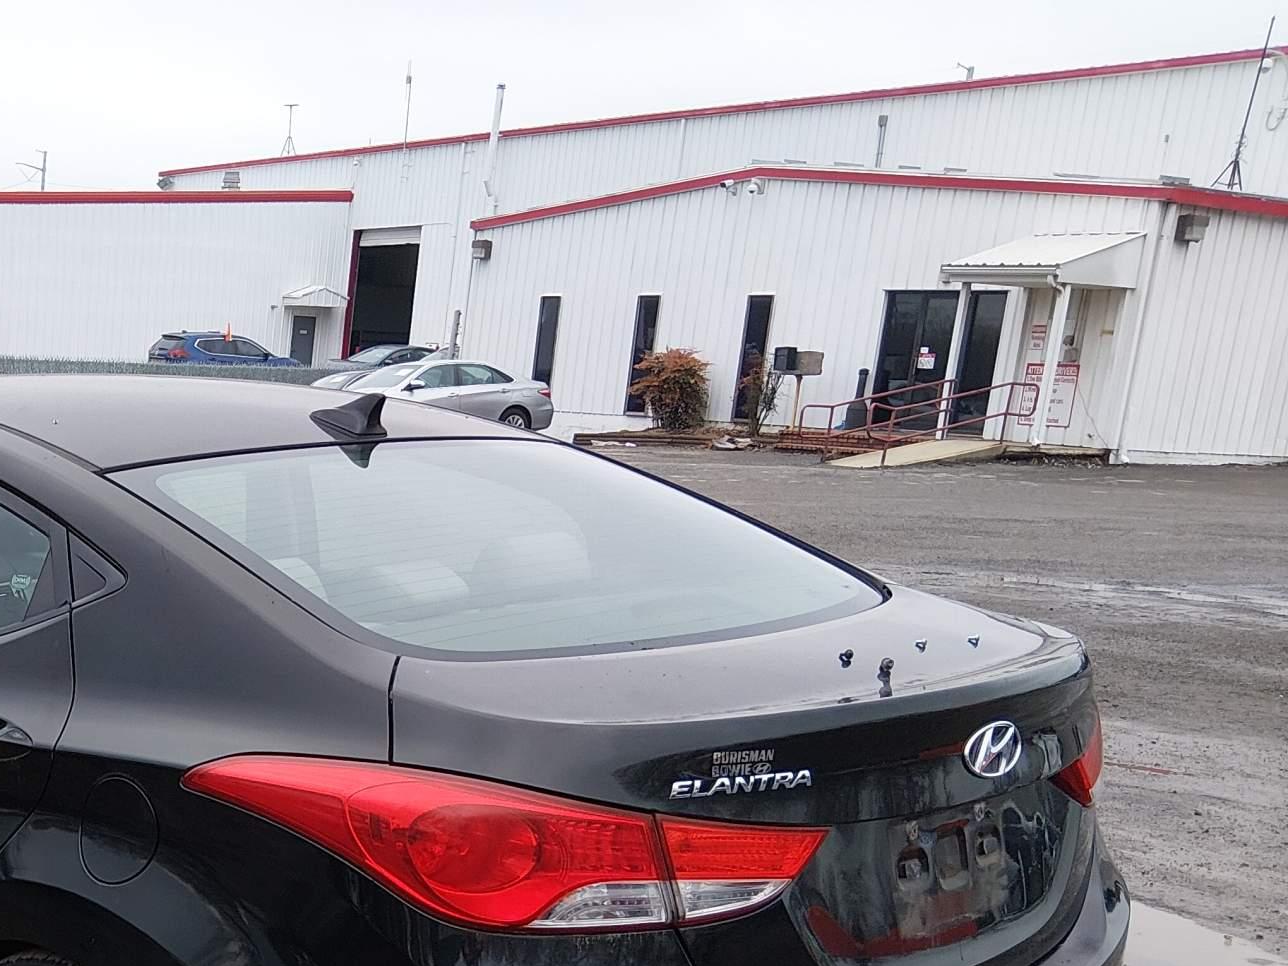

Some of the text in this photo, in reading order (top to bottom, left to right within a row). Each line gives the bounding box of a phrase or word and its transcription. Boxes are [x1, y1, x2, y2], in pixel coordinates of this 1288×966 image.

[712, 749, 774, 764] OURISMAN
[711, 764, 753, 778] BOWIE
[669, 770, 812, 799] ELANTRA
